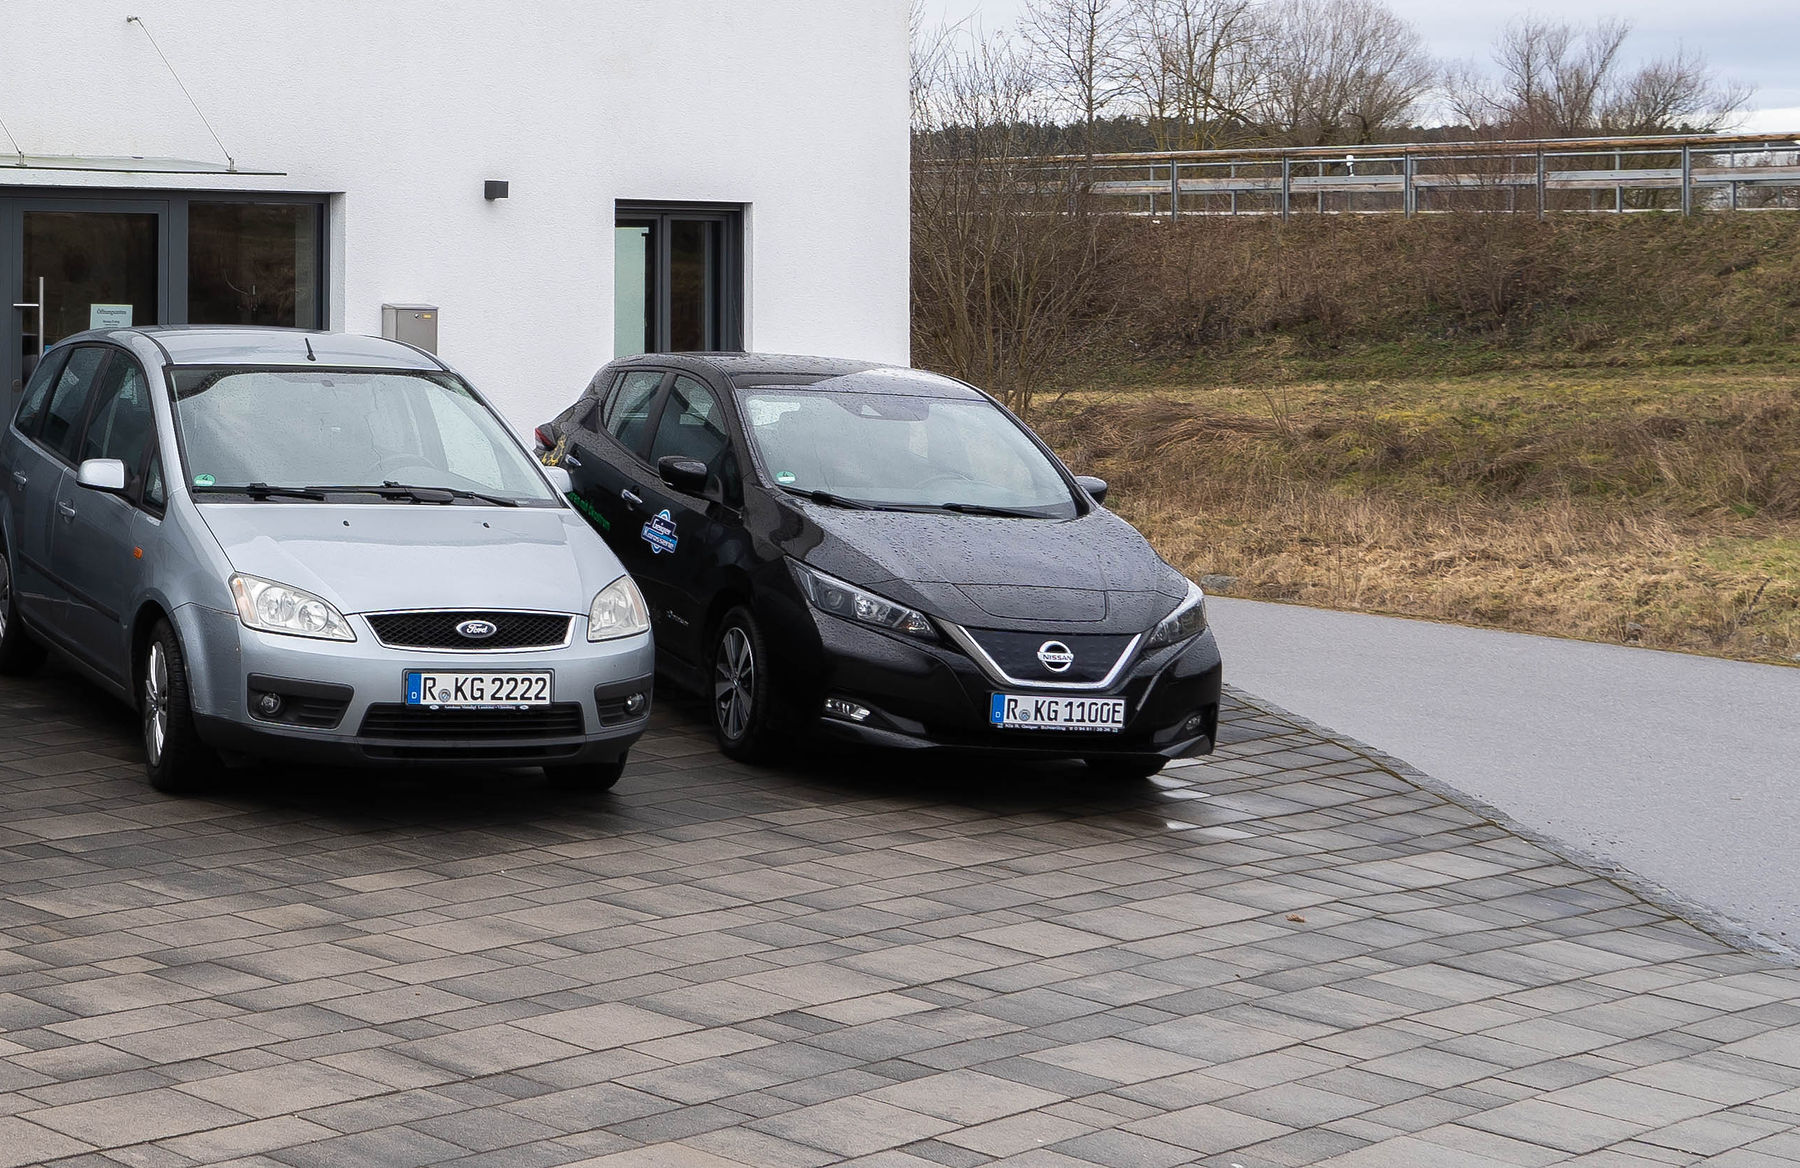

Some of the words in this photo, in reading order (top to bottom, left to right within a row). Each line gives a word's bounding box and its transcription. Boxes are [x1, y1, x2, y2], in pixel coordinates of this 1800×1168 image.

[466, 623, 488, 634] Ford
[1042, 653, 1073, 661] NISSAN
[422, 677, 437, 701] R
[454, 677, 485, 701] KG
[490, 677, 547, 701] 2222
[1006, 698, 1019, 720] R
[1034, 699, 1059, 722] KG
[1063, 701, 1123, 724] 1100E
